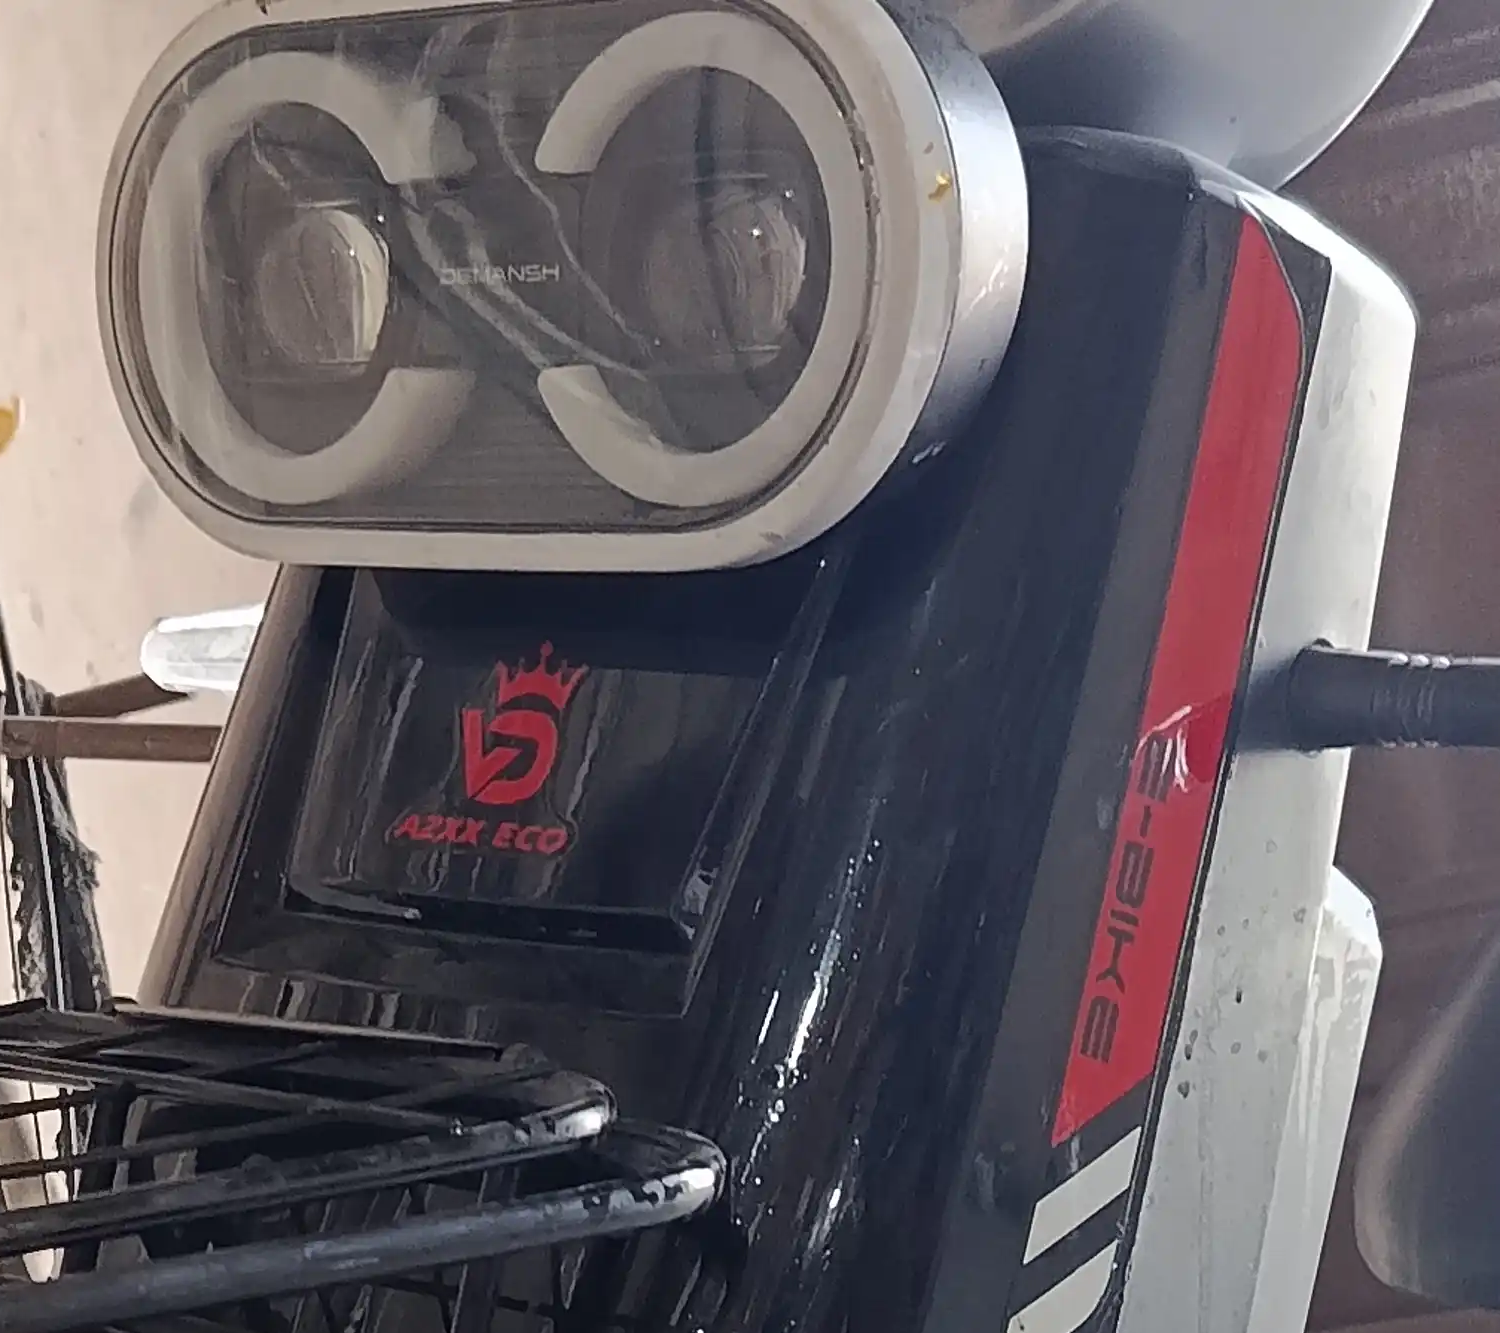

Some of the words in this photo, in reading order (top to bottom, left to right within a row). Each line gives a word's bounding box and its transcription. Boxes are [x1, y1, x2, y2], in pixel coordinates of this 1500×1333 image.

[393, 813, 486, 848] AZXX
[491, 820, 569, 855] ECO
[1079, 735, 1168, 1064] E-BIKE
